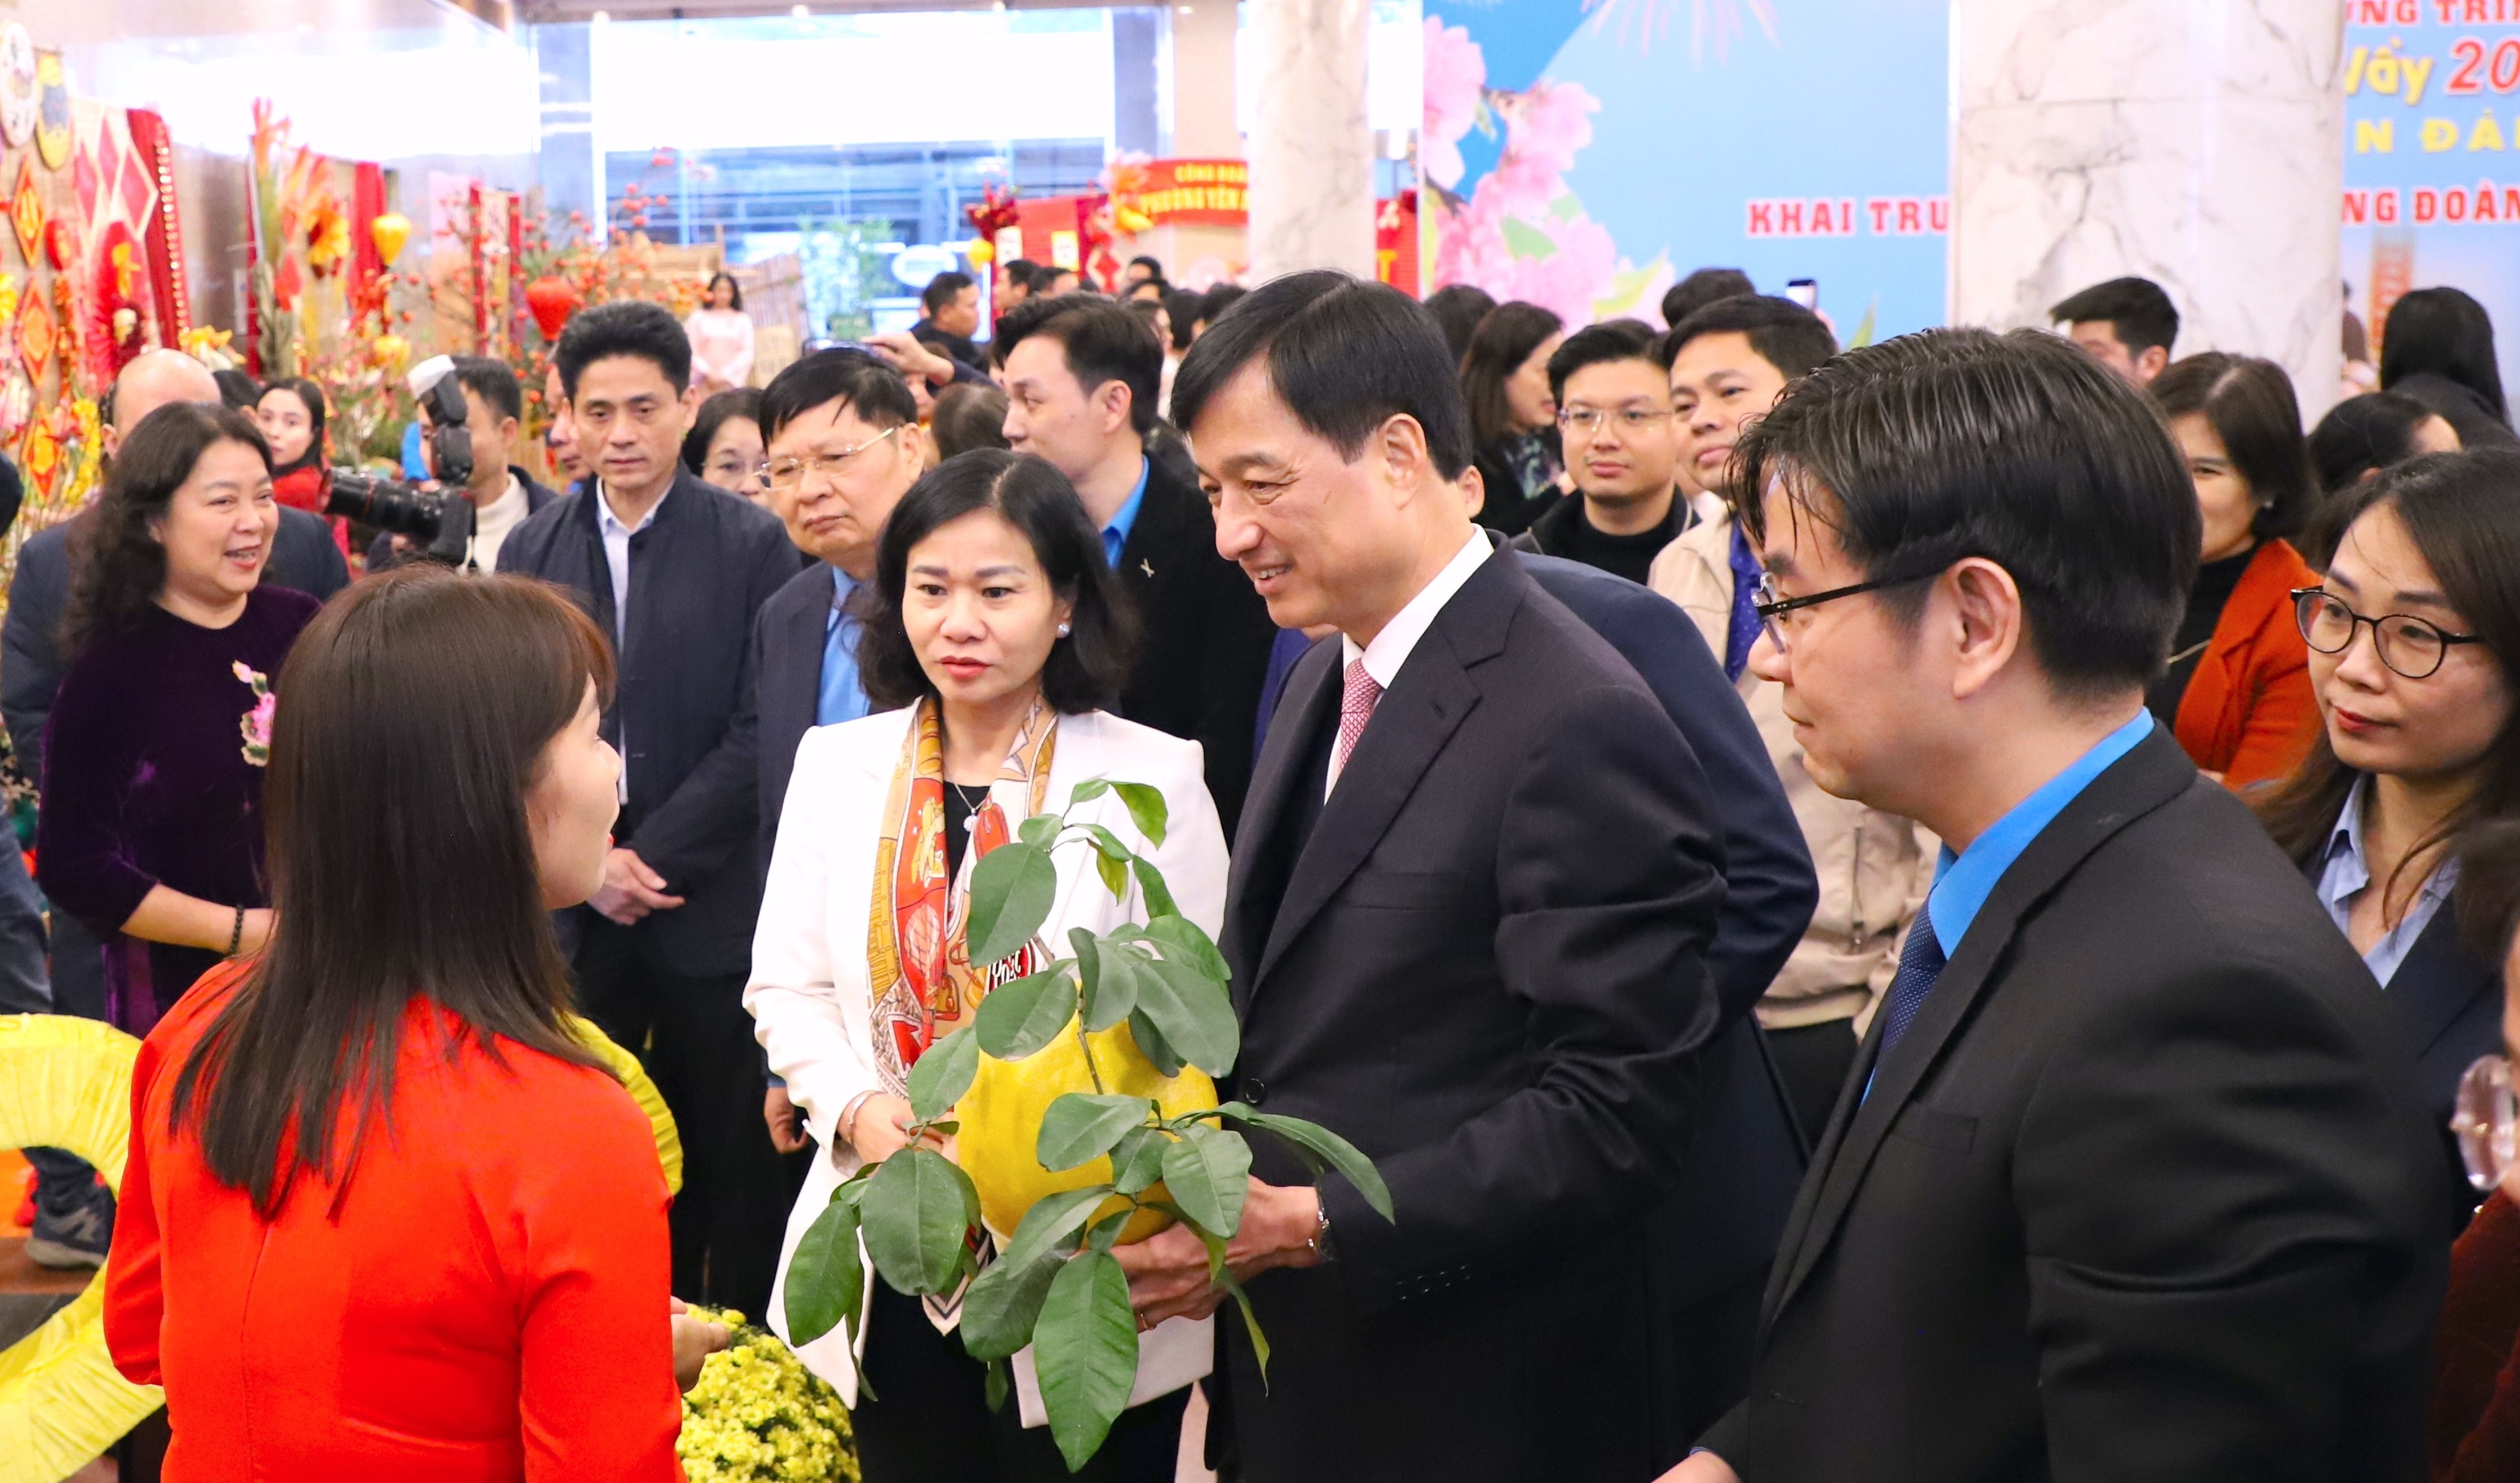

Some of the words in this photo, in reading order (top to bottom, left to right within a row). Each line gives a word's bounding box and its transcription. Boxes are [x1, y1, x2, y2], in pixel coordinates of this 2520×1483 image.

[2346, 0, 2417, 23] NG
[2436, 0, 2520, 22] TRI
[1750, 202, 1850, 233] KHAI
